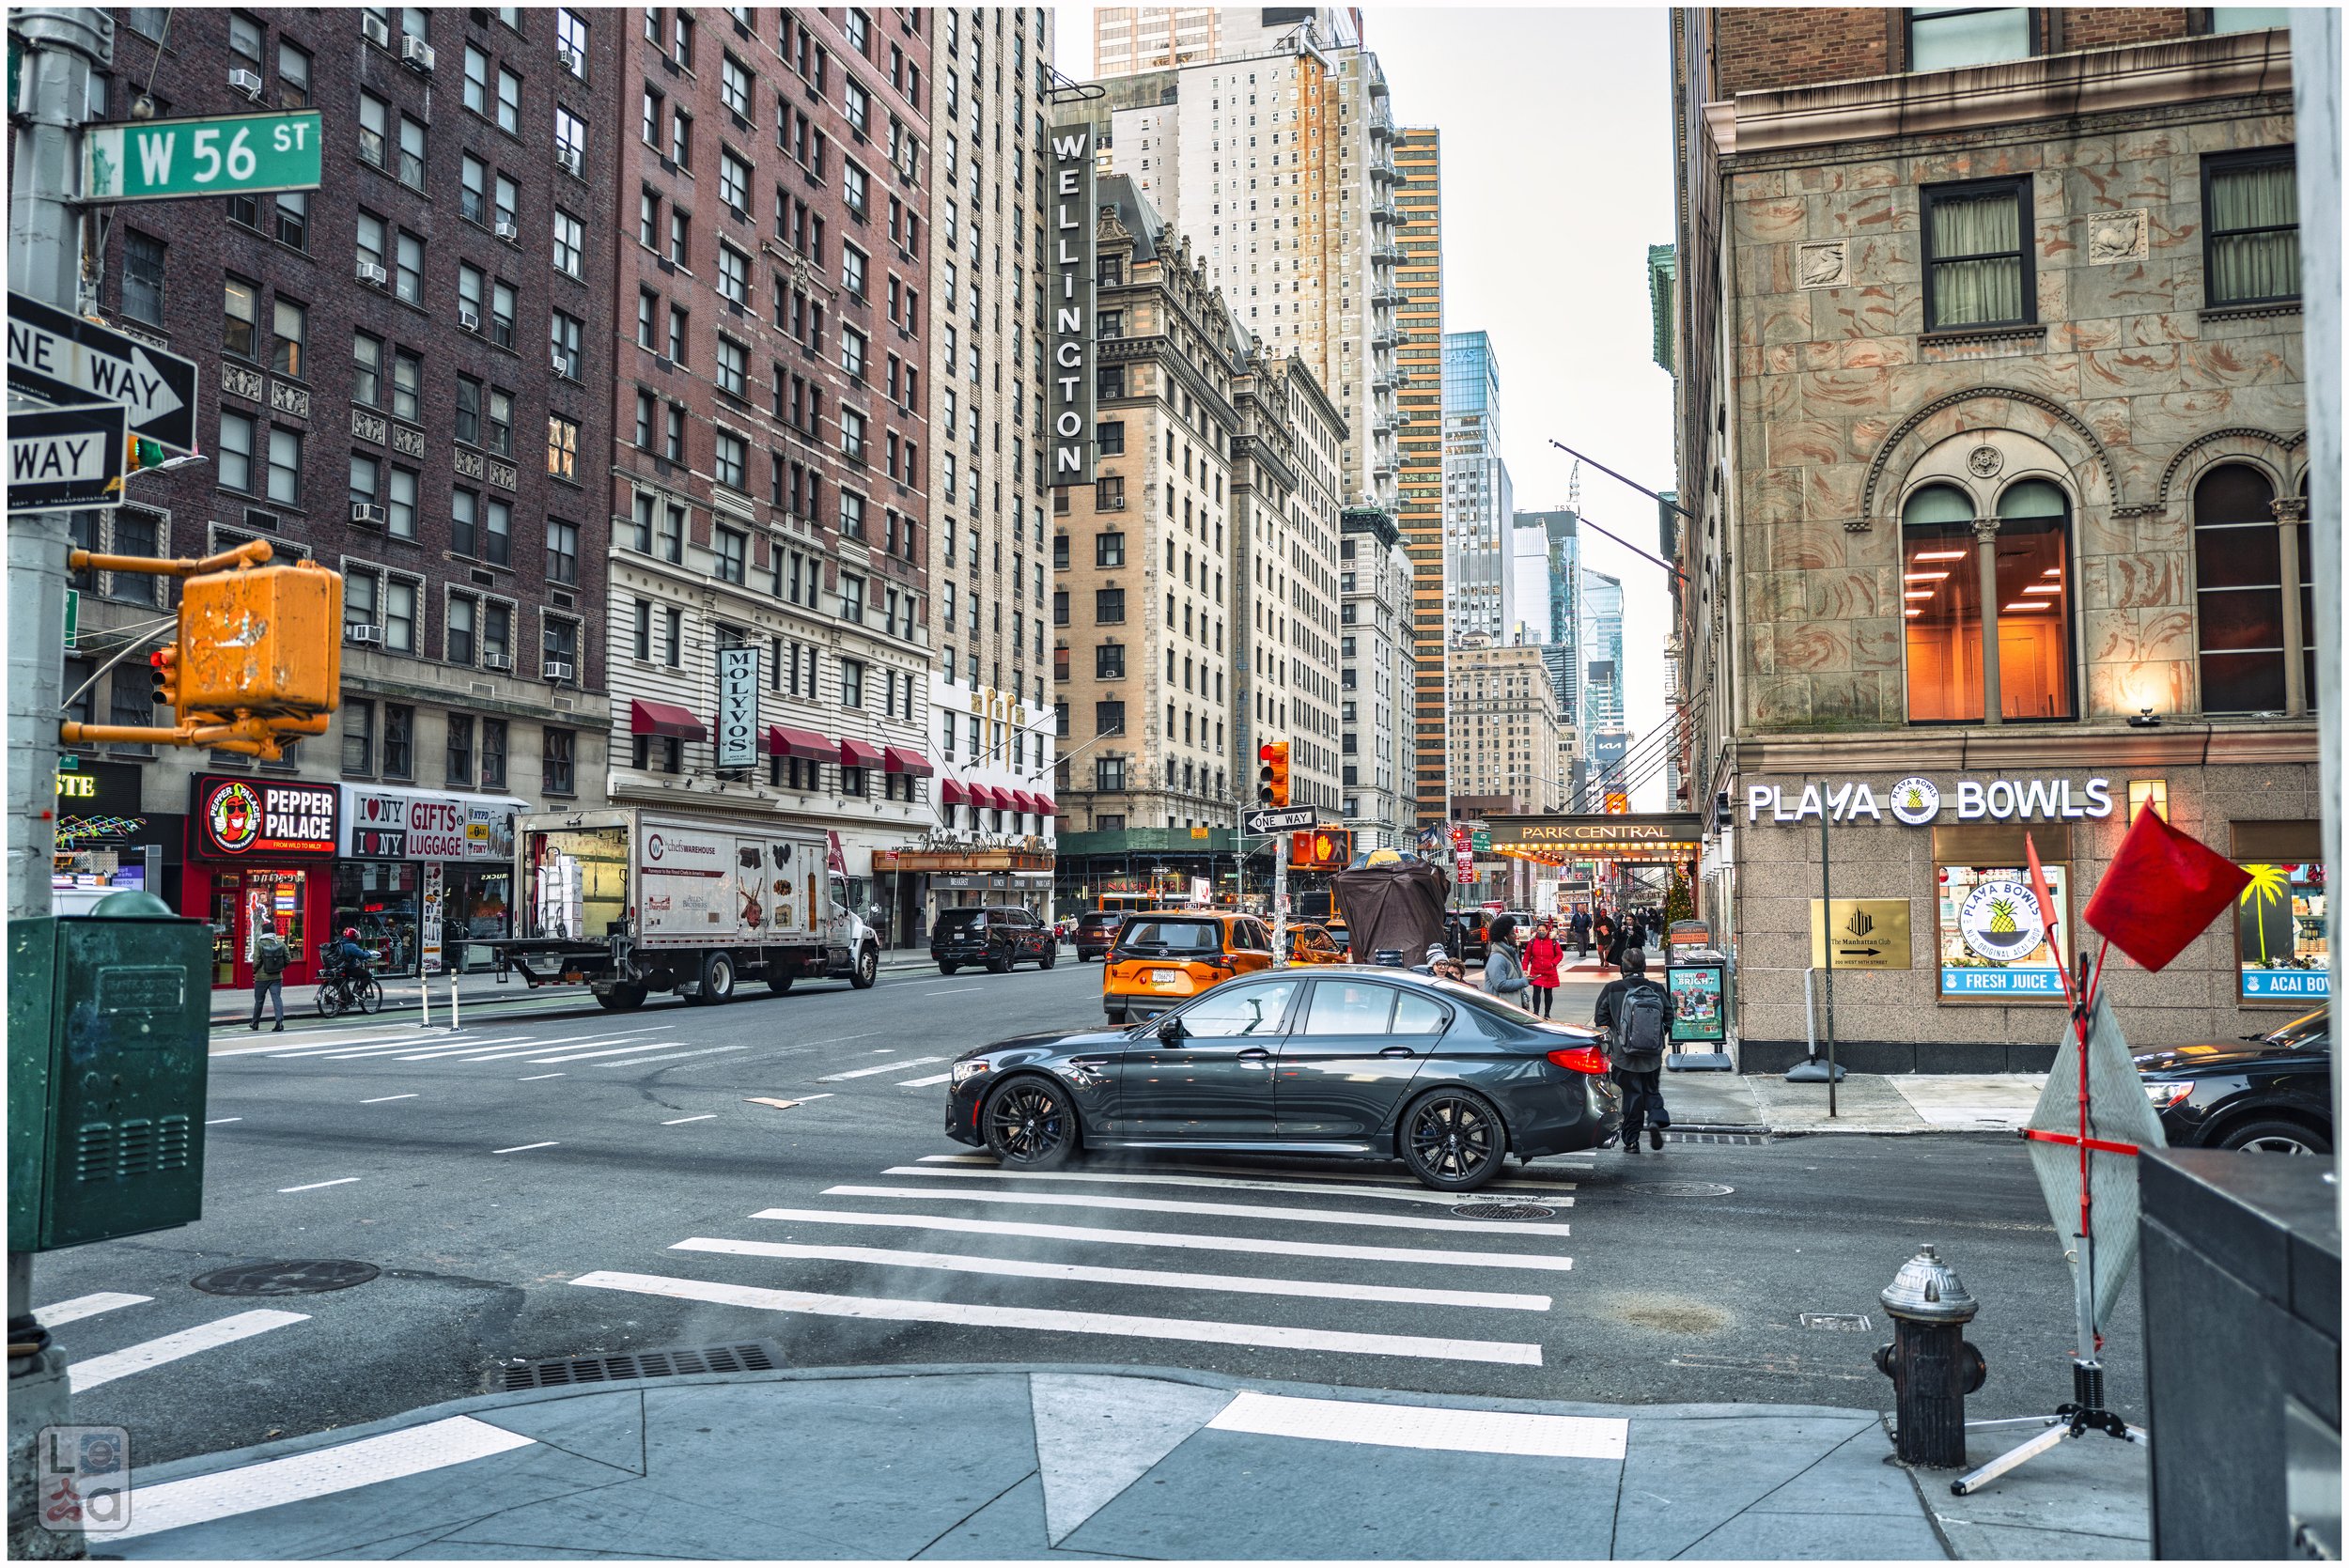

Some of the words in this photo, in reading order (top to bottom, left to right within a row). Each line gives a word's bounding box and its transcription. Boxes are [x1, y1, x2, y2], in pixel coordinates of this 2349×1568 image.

[138, 132, 176, 185] W
[193, 127, 257, 183] 56
[273, 122, 310, 152] ST
[1052, 133, 1087, 472] WELLINGTON
[8, 320, 54, 373] NE
[91, 355, 161, 410] WAY
[13, 439, 90, 480] WAY
[728, 652, 751, 753] MOLYVOS
[210, 785, 233, 816] PEPPER
[241, 787, 261, 819] PALACE
[266, 788, 333, 815] PEPPER
[1748, 782, 1881, 822] PLAYA
[1956, 778, 2113, 819] BOWLS
[1892, 780, 1912, 799] PLAYA
[1916, 779, 1937, 798] BOWLS
[360, 798, 367, 820] I
[381, 800, 404, 823] NY
[411, 802, 457, 832] GIFTS
[457, 815, 463, 826] &
[473, 811, 490, 820] NYPD
[1255, 816, 1275, 828] ONE
[1284, 814, 1307, 824] WAY
[265, 814, 331, 840] PALACE
[1522, 827, 1571, 839] PARK
[1575, 826, 1670, 838] CENTRAL
[358, 831, 366, 854] I
[379, 833, 402, 856] NY
[410, 834, 461, 856] LUGGAGE
[473, 846, 488, 854] FDNY
[1964, 884, 1998, 917] PLAYA
[2003, 883, 2039, 916] BOWLS
[1977, 942, 2010, 957] ORIGINAL
[2013, 943, 2030, 956] ACAI
[2029, 927, 2041, 945] SHOP
[1678, 977, 1715, 986] BRIGHT
[1966, 973, 2006, 988] FRESH
[2012, 974, 2047, 988] JUICE
[2270, 976, 2301, 991] ACAI
